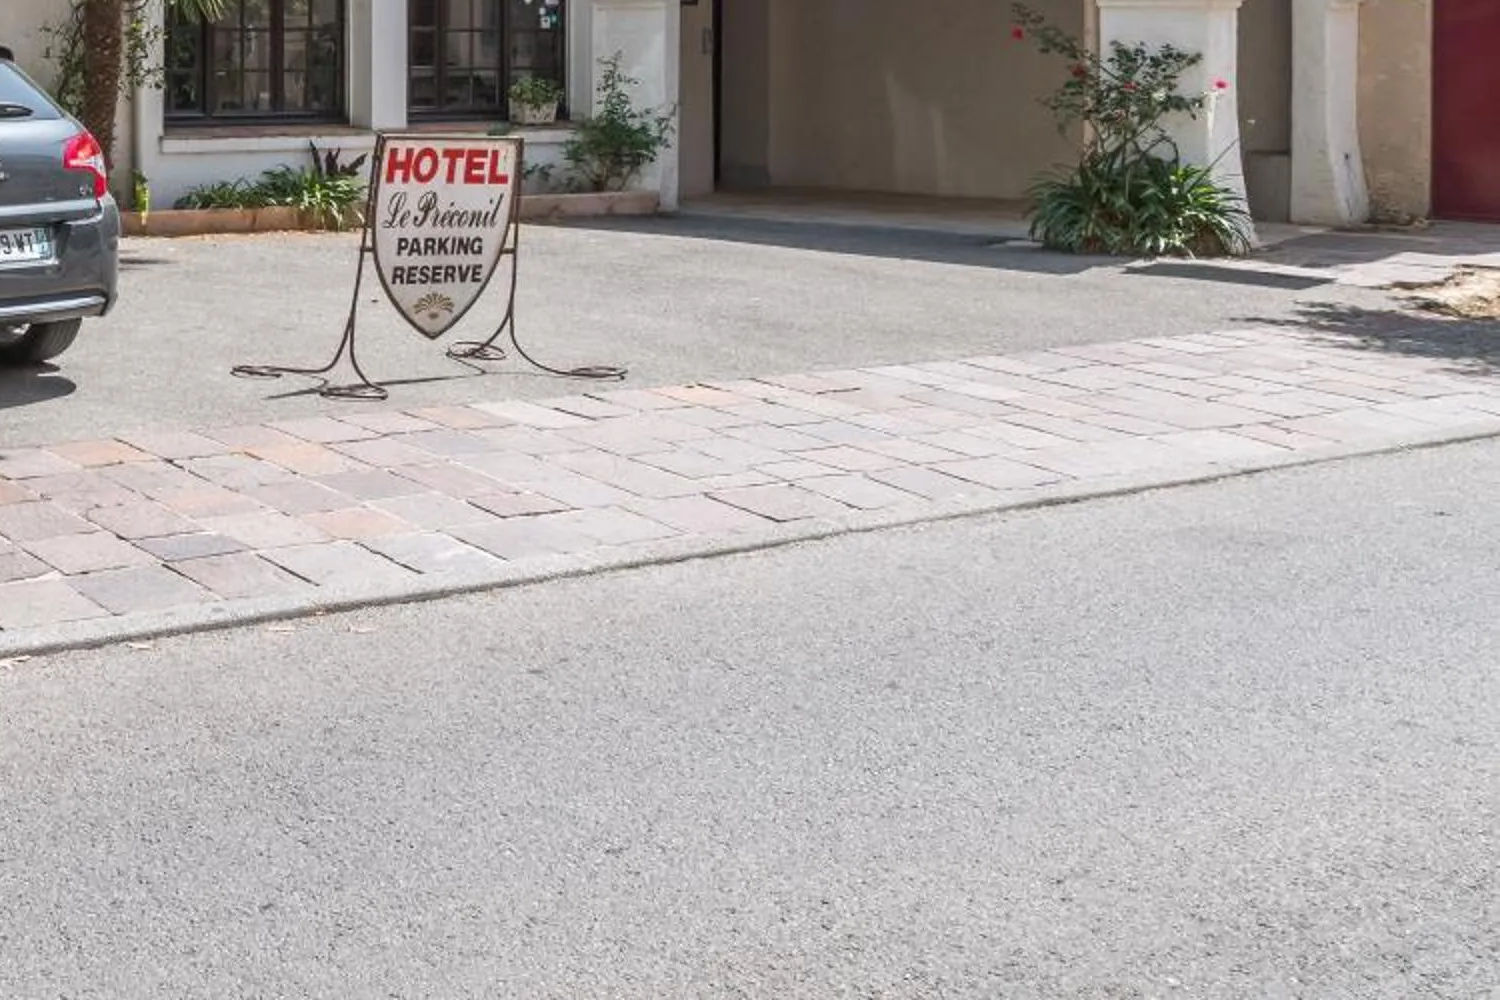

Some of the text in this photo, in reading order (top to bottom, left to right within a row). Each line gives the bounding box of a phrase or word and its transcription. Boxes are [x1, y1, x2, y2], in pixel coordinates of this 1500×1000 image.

[385, 147, 509, 185] HOTEL
[381, 190, 505, 229] Le Préconil
[396, 236, 483, 257] PARKING
[391, 264, 483, 285] RESERVE
